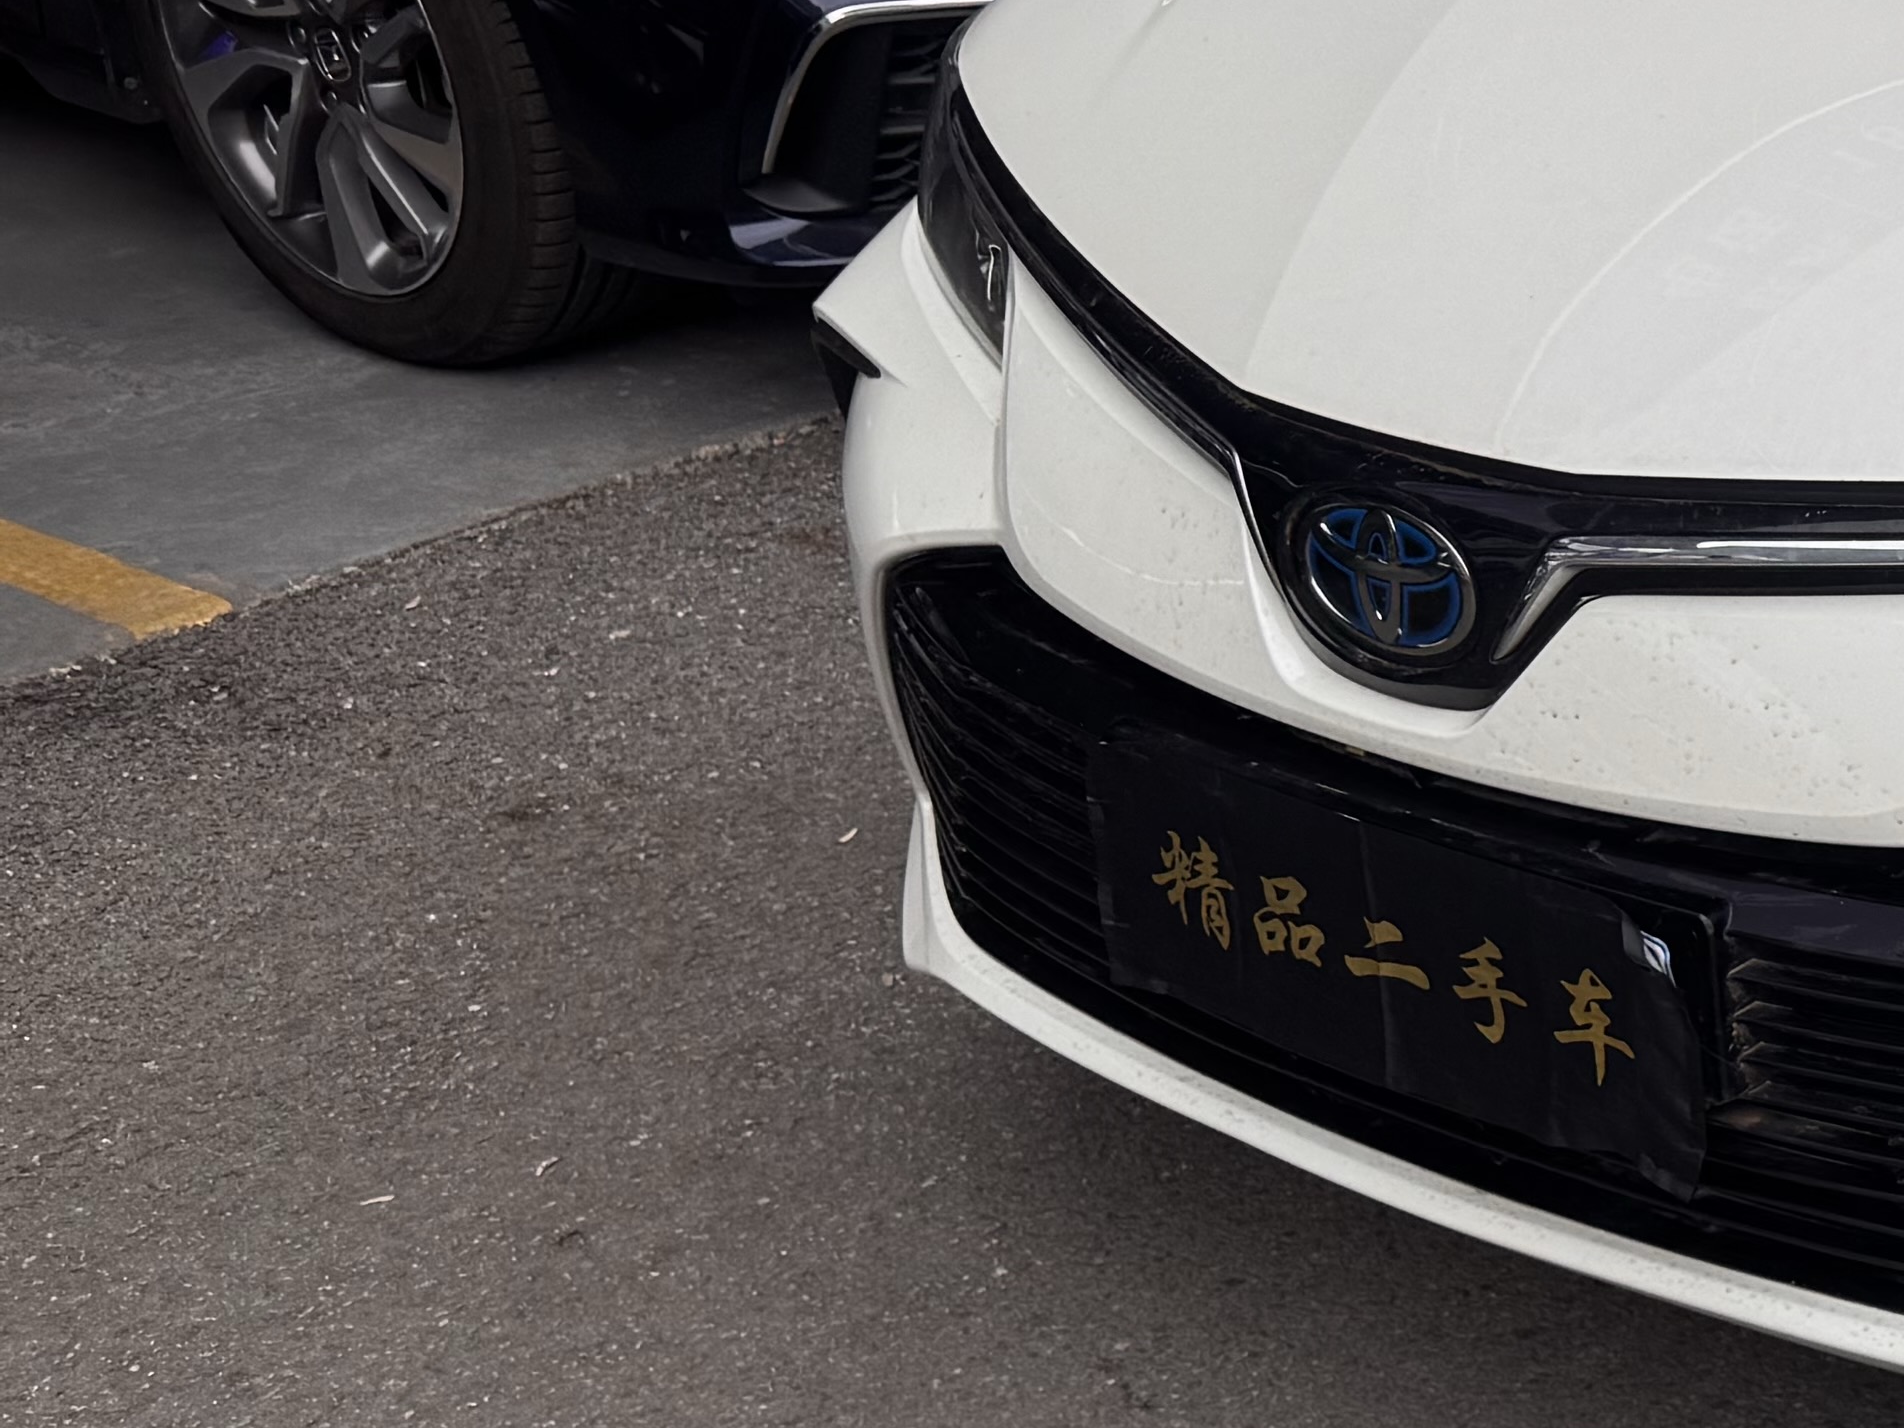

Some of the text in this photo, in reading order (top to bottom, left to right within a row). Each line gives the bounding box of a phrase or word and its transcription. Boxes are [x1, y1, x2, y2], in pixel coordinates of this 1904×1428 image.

[1152, 830, 1636, 1088] 精品二手车
